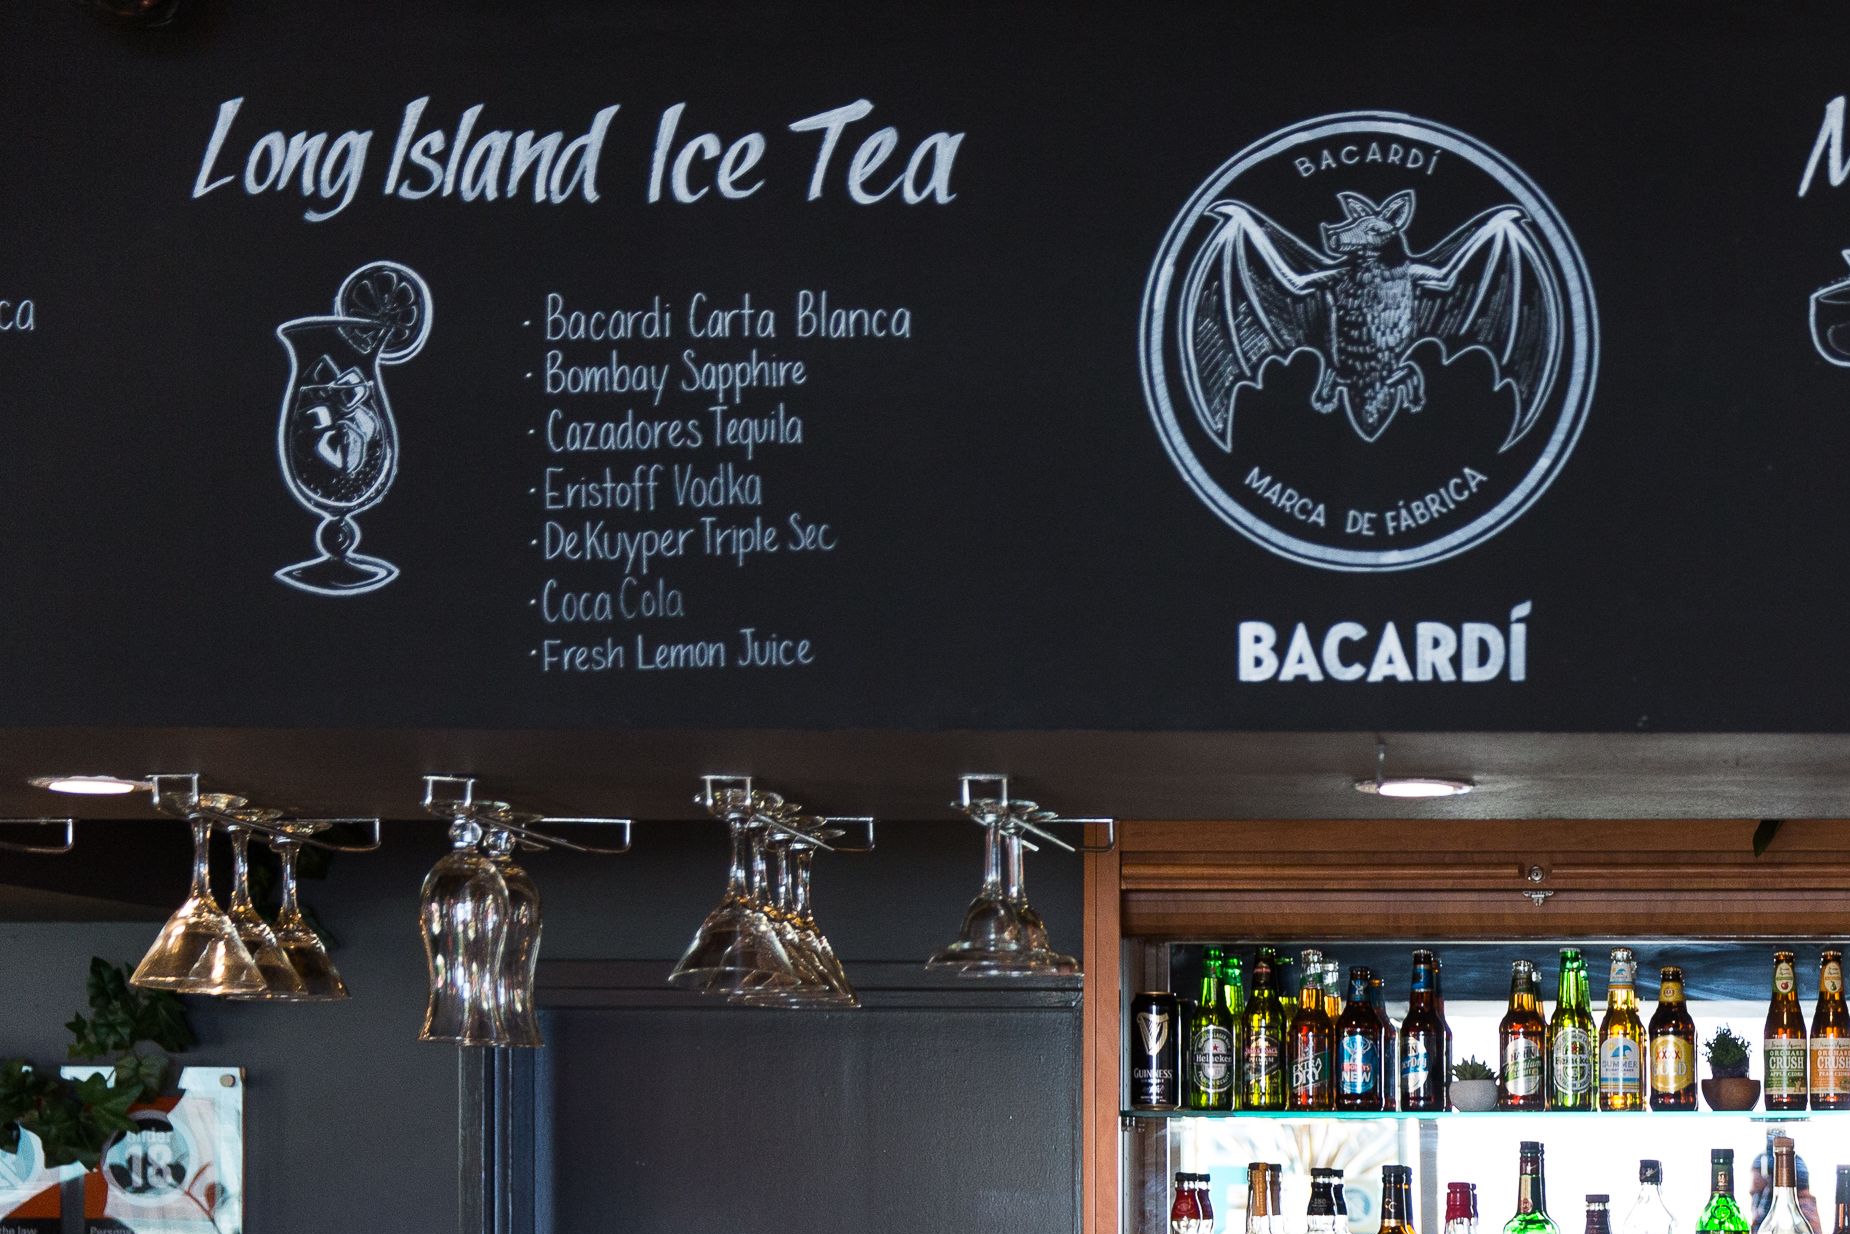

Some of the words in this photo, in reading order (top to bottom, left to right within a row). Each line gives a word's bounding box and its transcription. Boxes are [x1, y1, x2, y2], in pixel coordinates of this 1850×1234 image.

[190, 96, 374, 223] Long
[382, 95, 621, 205] Island
[646, 101, 767, 204] Ice
[787, 97, 966, 206] Tea
[1294, 142, 1441, 178] BACARDÍ
[545, 293, 671, 341] Bacardi
[688, 292, 776, 338] Carta
[795, 289, 912, 339] Blanca
[544, 349, 670, 405] Bombay
[680, 348, 807, 406] Sapphire
[545, 408, 703, 453] Cazadores
[708, 404, 803, 460] Tequila
[544, 463, 664, 512] Eristoff
[673, 464, 762, 508] Vodka
[1244, 466, 1326, 528] MARCA
[1345, 509, 1377, 536] DE
[1384, 466, 1488, 537] FÁBRICA
[544, 520, 694, 574] DeKuyper
[699, 516, 779, 564] Triple
[788, 512, 836, 551] Sec
[541, 578, 613, 623] Coca
[619, 576, 684, 619] Cola
[543, 637, 624, 672] Fresh
[636, 634, 726, 670] Lemon
[737, 629, 814, 671] Juice
[1235, 599, 1533, 684] BACARDÍ
[1293, 1068, 1320, 1087] DRY
[1342, 1071, 1371, 1082] NEW
[1769, 1057, 1804, 1069] CRUSH
[1817, 1057, 1850, 1069] CRUSH
[125, 1144, 173, 1188] 18
